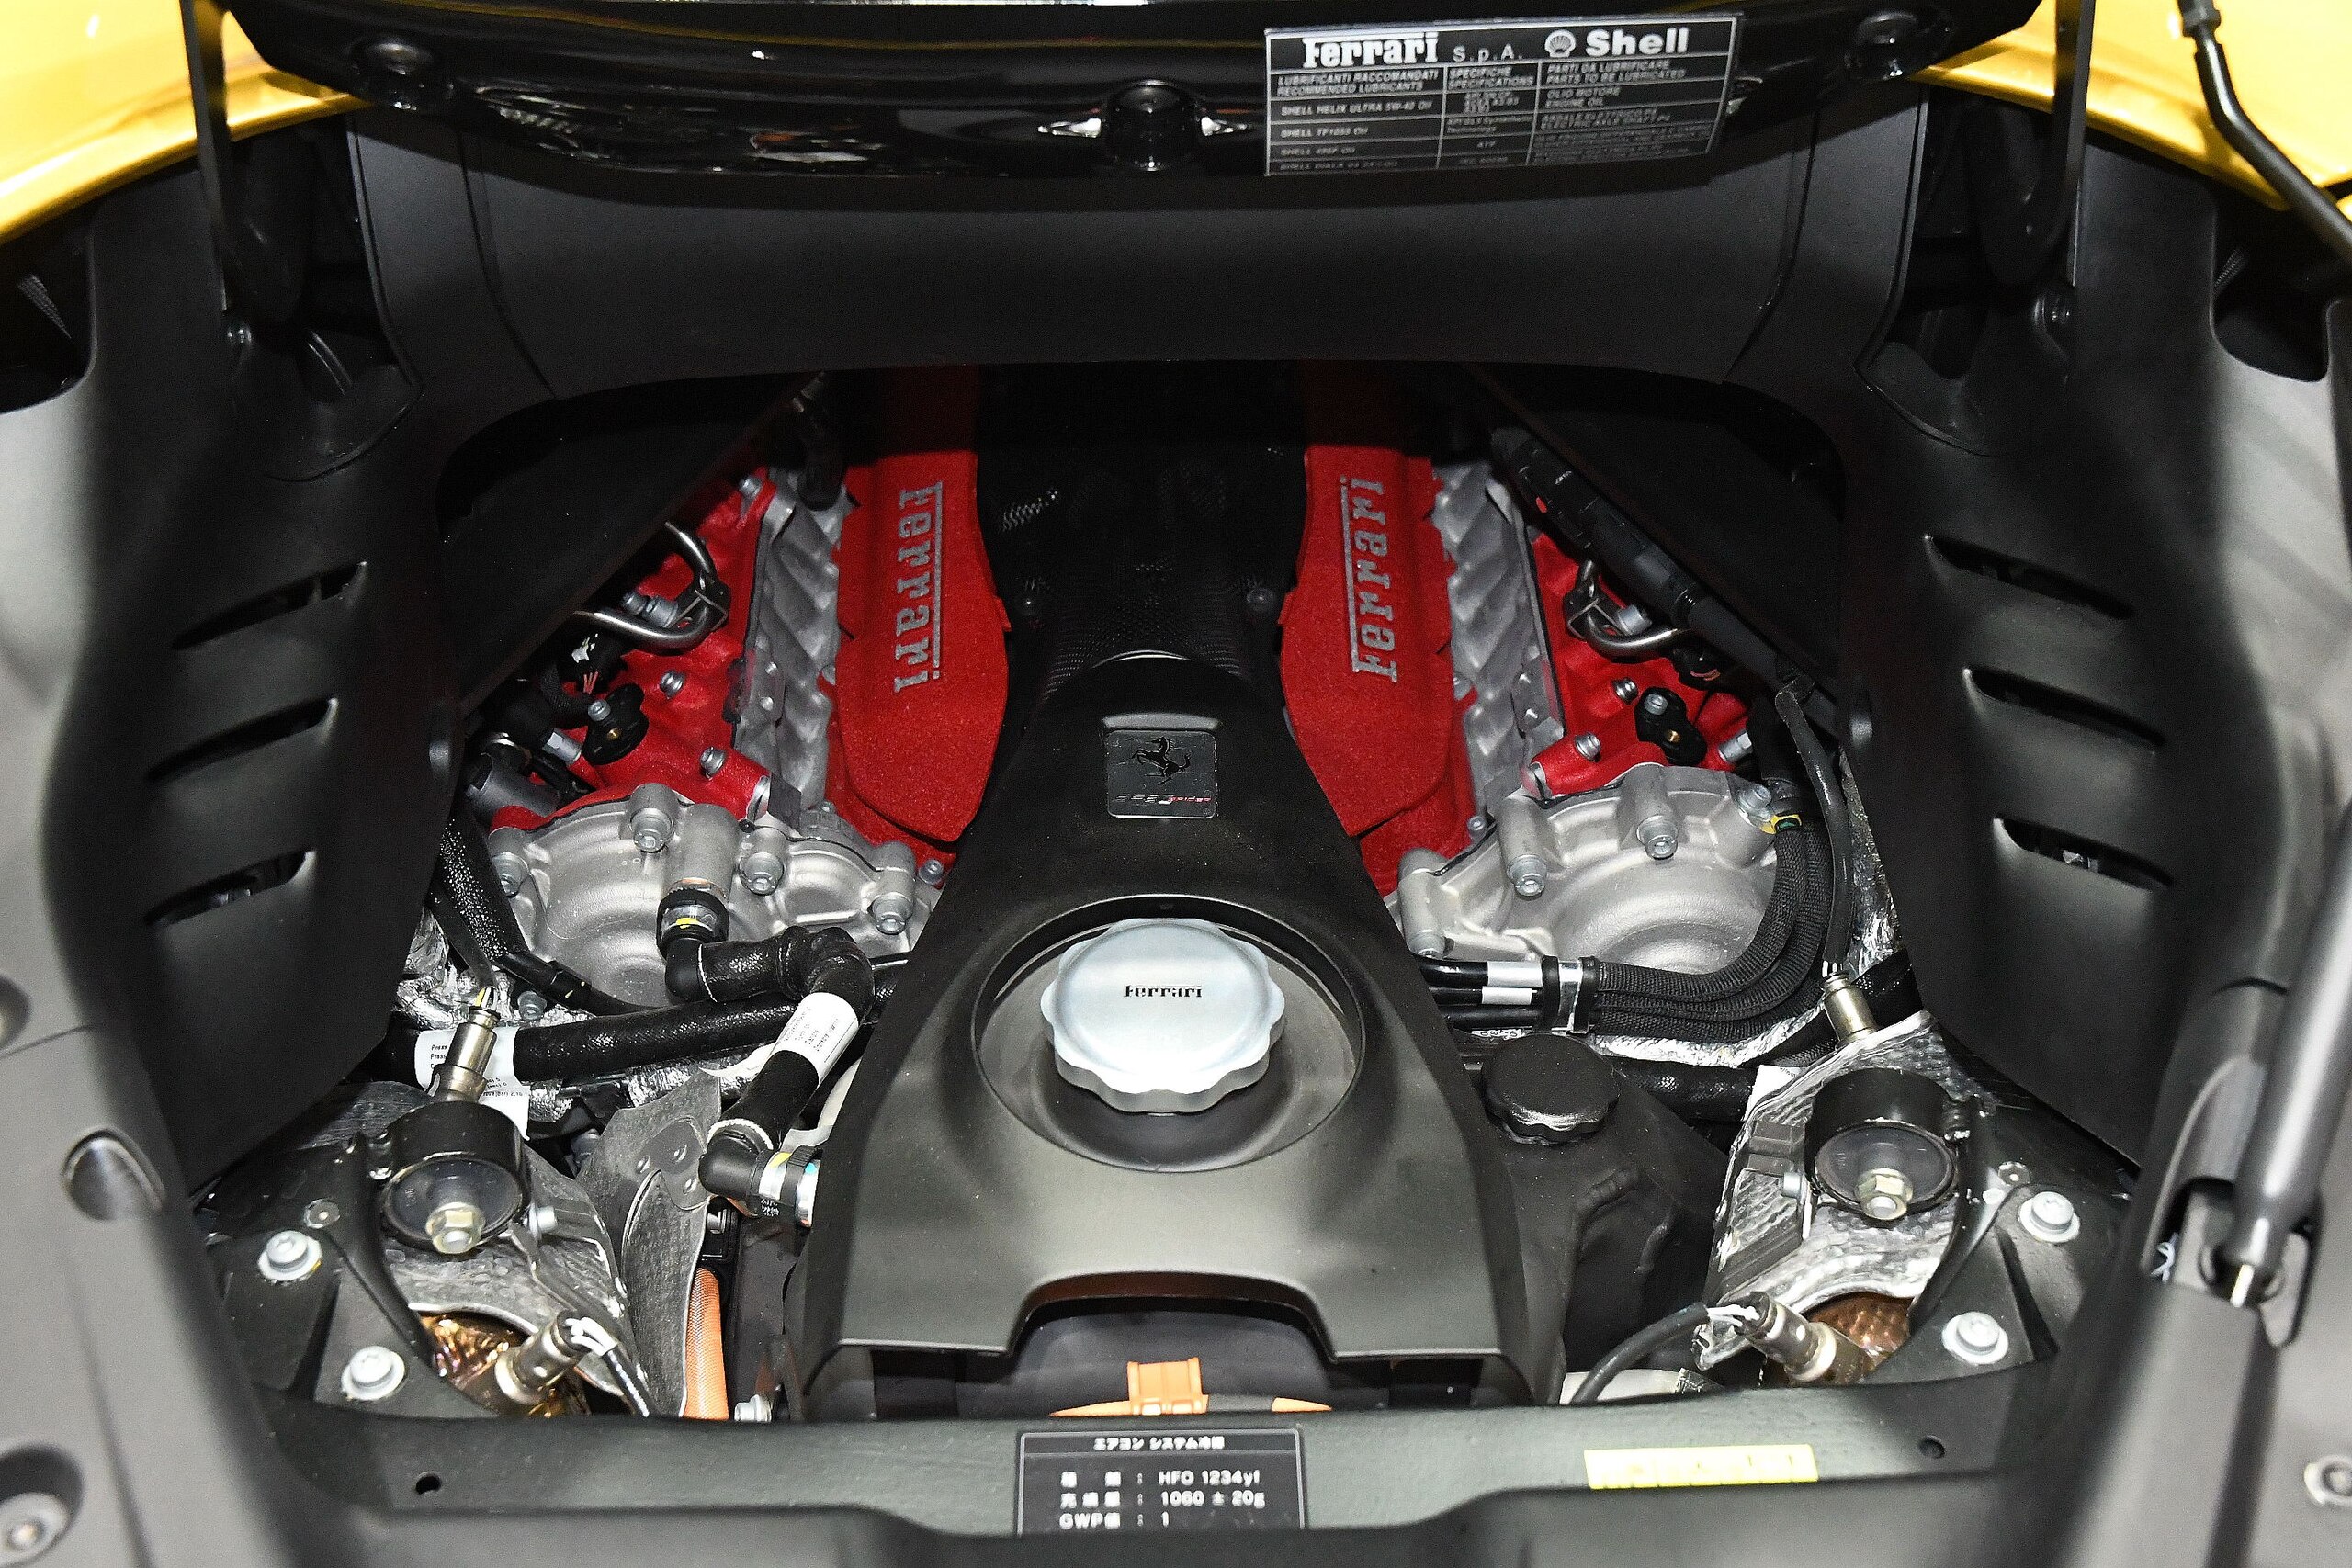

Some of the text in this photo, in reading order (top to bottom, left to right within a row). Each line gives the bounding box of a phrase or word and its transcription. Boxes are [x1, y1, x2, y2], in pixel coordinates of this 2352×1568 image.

[1303, 32, 1439, 68] Ferrari
[1586, 28, 1690, 57] Shell
[894, 480, 944, 693] Ferrari
[1340, 474, 1397, 682] Ferrari
[1159, 1470, 1194, 1485] HFO
[1161, 1490, 1204, 1506] 1060
